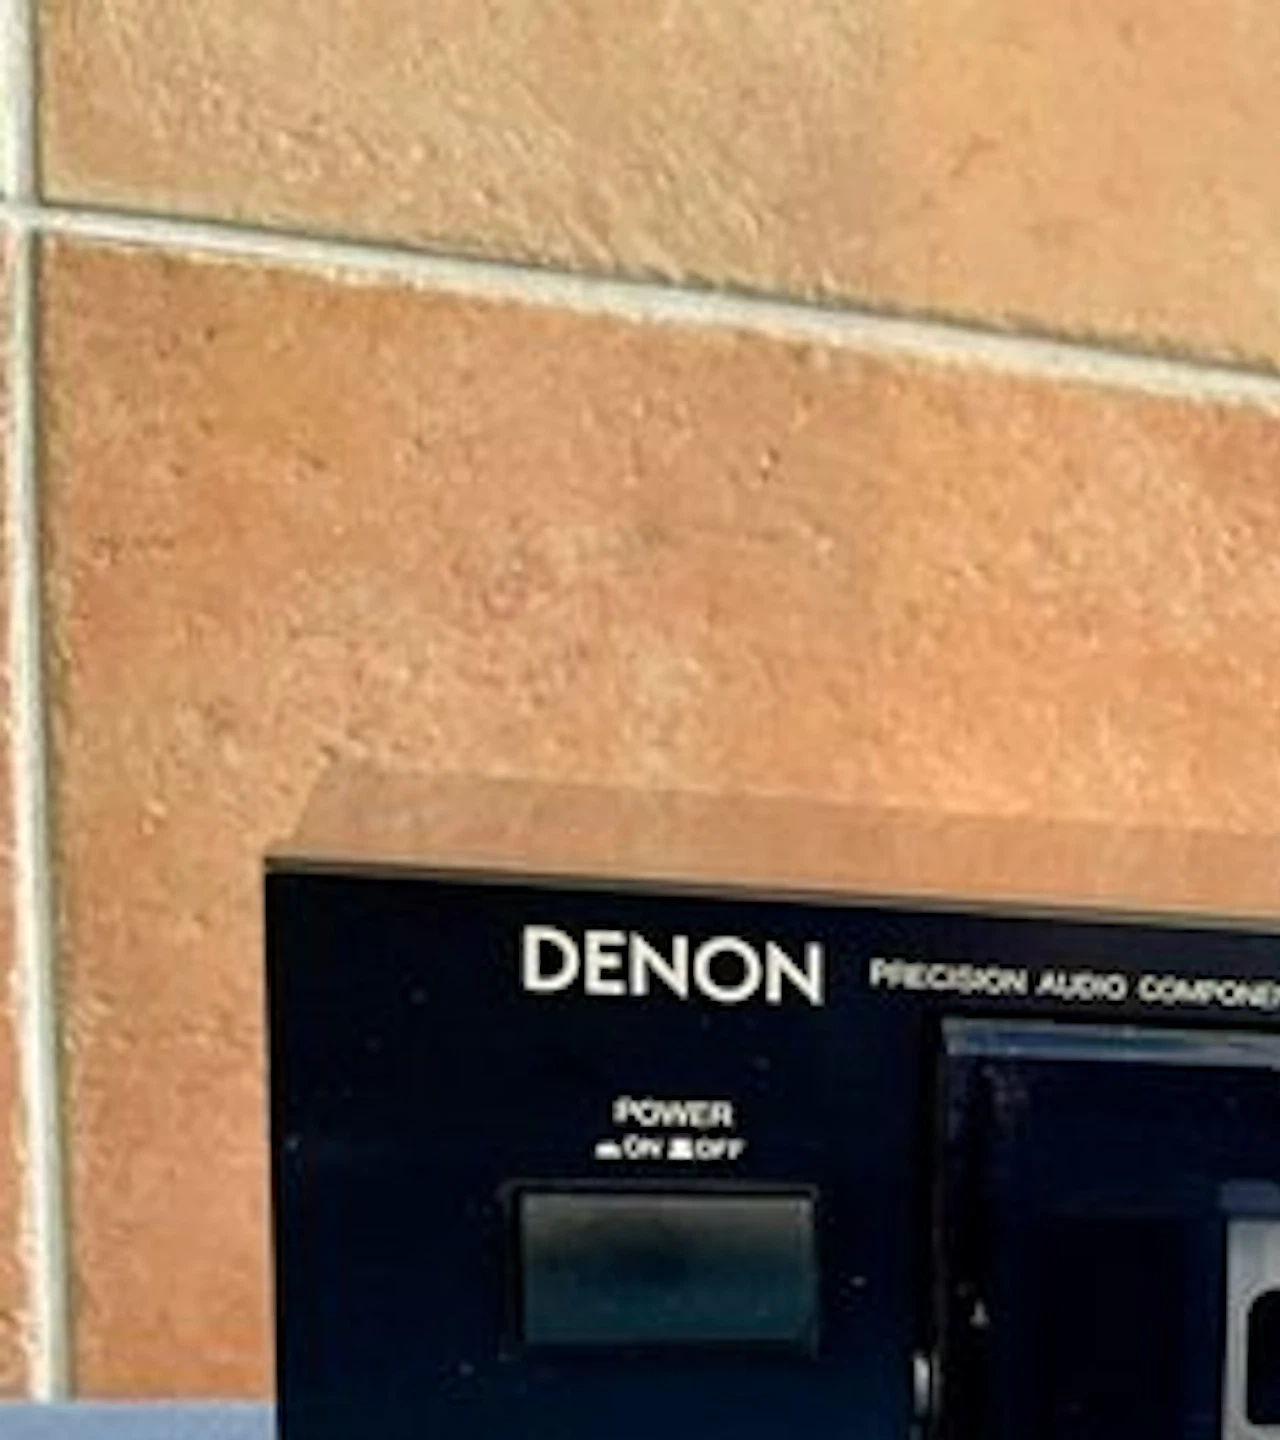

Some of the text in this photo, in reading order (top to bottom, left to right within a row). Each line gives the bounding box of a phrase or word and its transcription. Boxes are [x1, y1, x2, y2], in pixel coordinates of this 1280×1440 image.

[521, 925, 825, 1006] DENON
[869, 956, 1028, 996] PRECISION
[1035, 969, 1128, 1001] AUDIO
[611, 1094, 733, 1129] POWER
[622, 1132, 746, 1161] ON OFF
